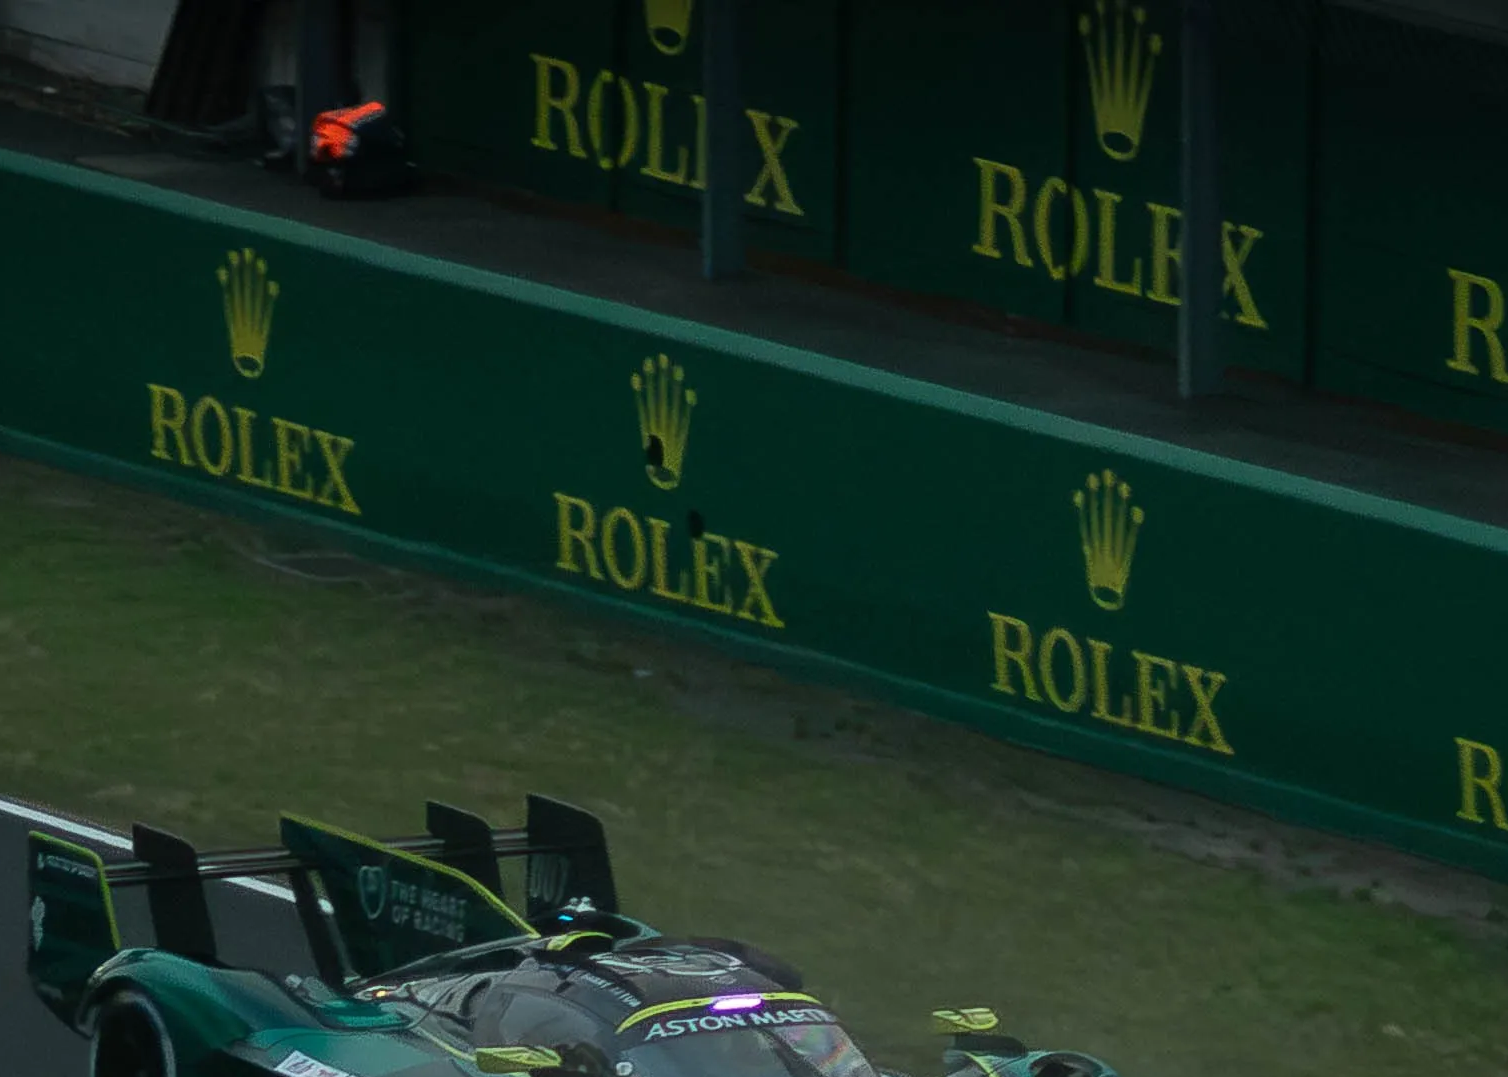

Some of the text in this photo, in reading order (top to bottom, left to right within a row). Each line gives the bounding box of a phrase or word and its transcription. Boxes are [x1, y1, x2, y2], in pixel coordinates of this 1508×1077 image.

[147, 383, 362, 516] ROLEX
[554, 491, 786, 629] ROLEX
[987, 612, 1233, 756] ROLEX
[643, 1014, 747, 1042] ASTON
